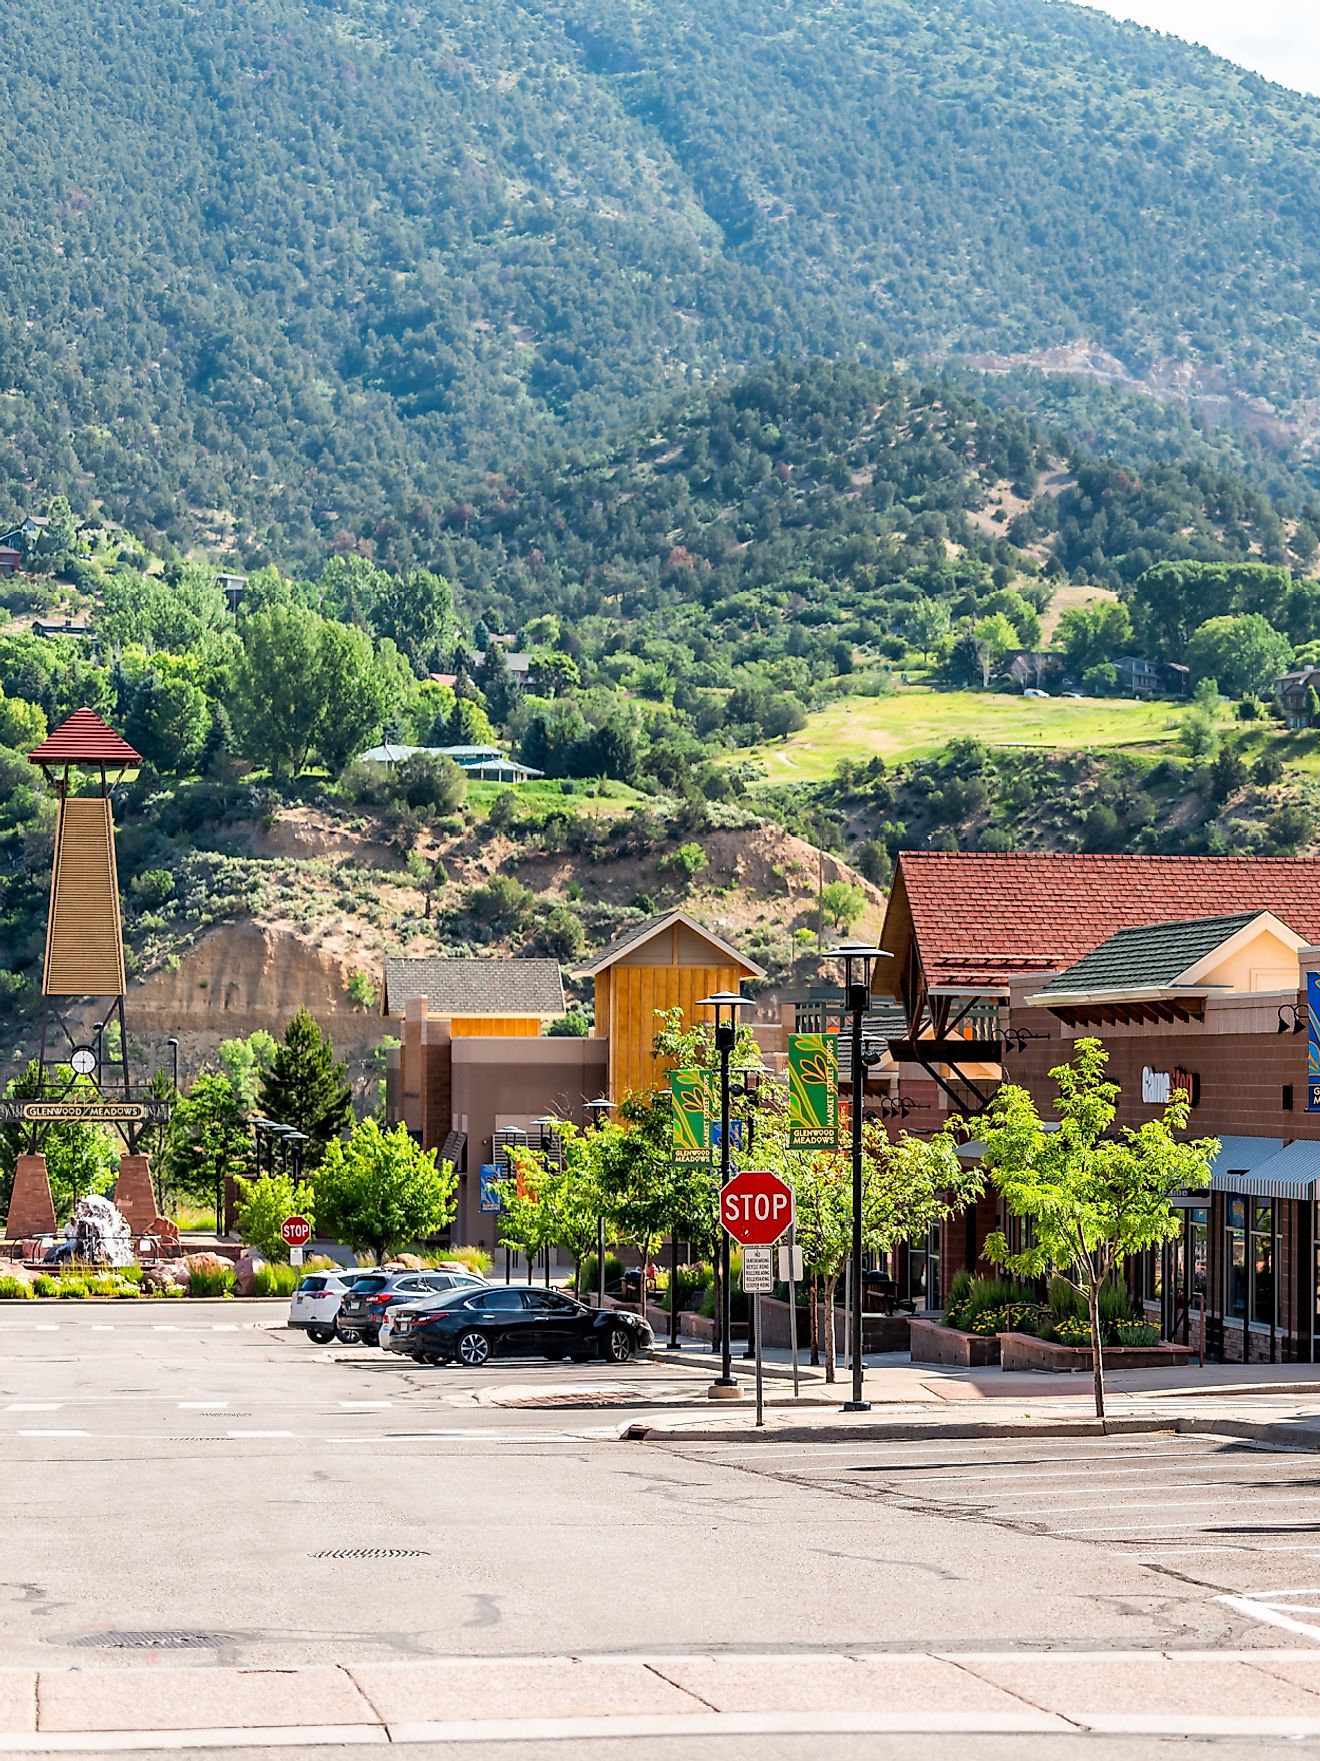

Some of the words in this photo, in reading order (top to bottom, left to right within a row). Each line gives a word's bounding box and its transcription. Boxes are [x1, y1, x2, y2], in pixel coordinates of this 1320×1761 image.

[826, 1039, 834, 1064] SHOPS
[826, 1066, 834, 1092] STREET
[29, 1107, 82, 1116] GLENWOOD
[90, 1107, 138, 1116] MEADOWS
[826, 1095, 834, 1126] MARKET
[793, 1129, 835, 1137] GLENWOOD
[725, 1193, 788, 1221] STOP
[283, 1224, 309, 1238] STOP
